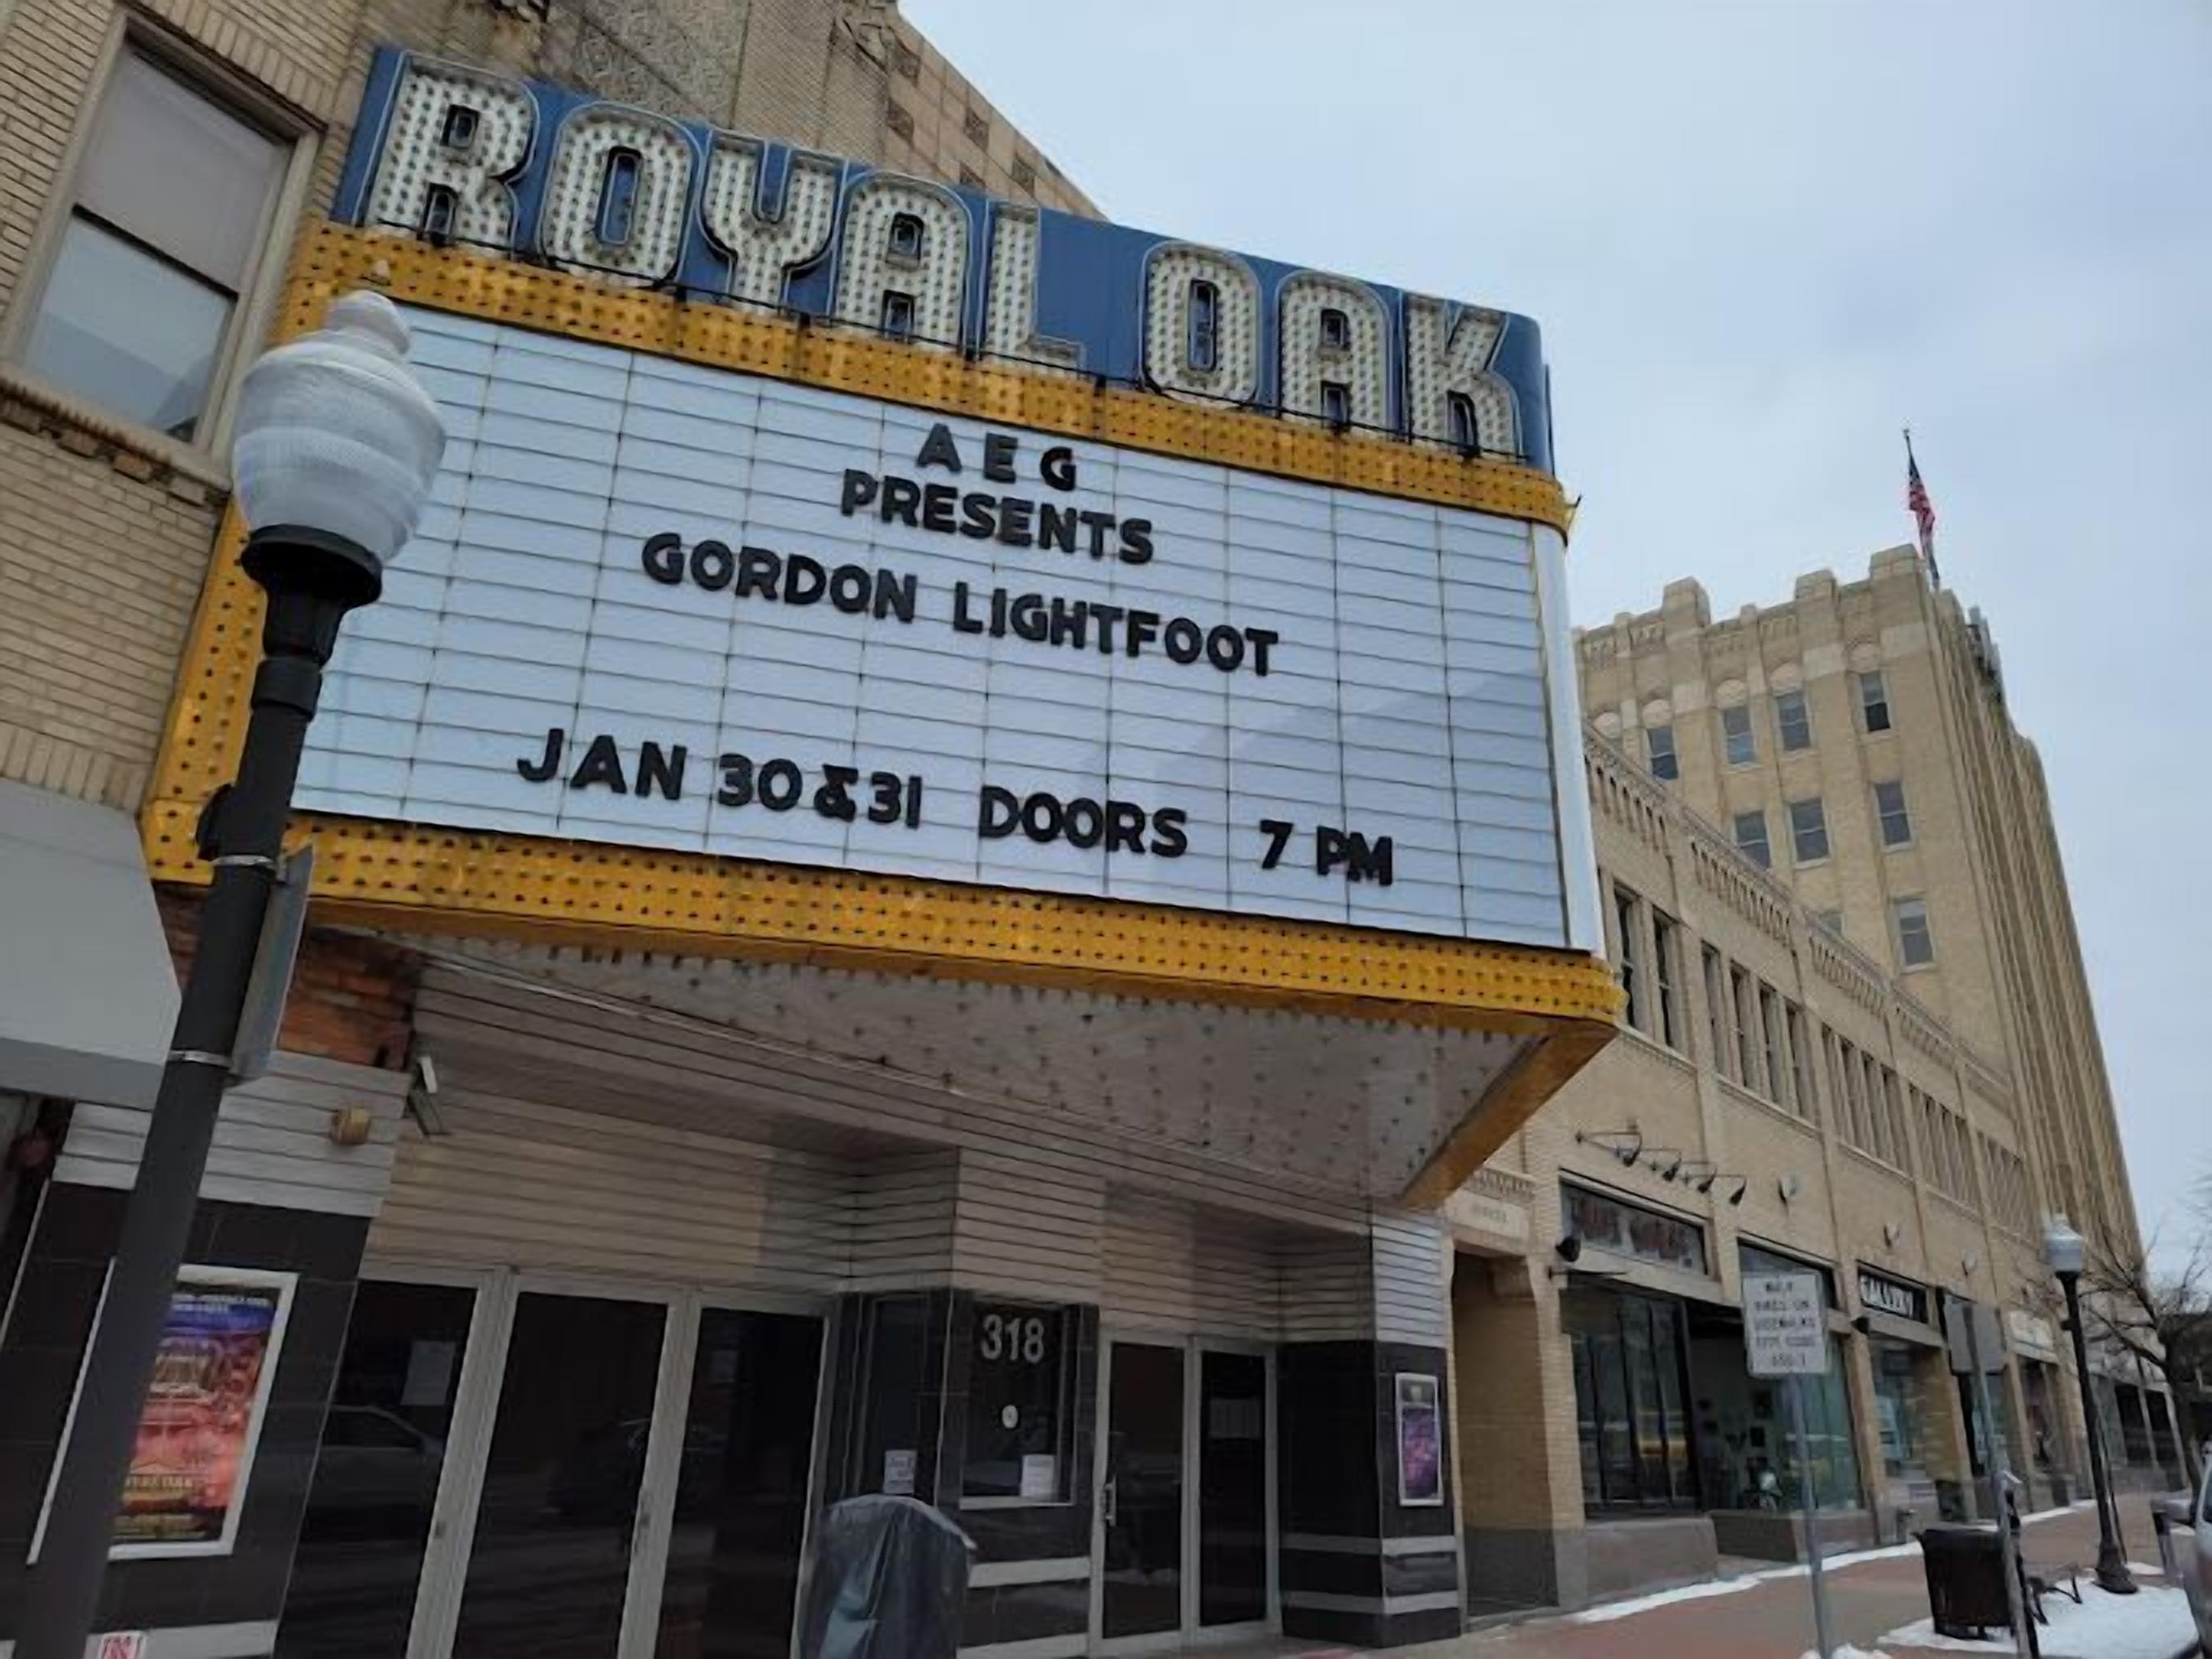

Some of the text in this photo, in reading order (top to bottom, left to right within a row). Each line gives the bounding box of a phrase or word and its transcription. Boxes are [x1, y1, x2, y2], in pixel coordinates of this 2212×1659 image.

[358, 54, 1522, 460] ROYAL OAK
[840, 468, 1153, 565] PRESENTS
[641, 532, 1279, 677] GORDON LIGHTFOOT
[516, 728, 687, 801] JAN
[978, 784, 1189, 859] DOORS
[1259, 818, 1295, 870] 7
[1316, 825, 1394, 887] PM
[981, 1313, 1044, 1365] 318
